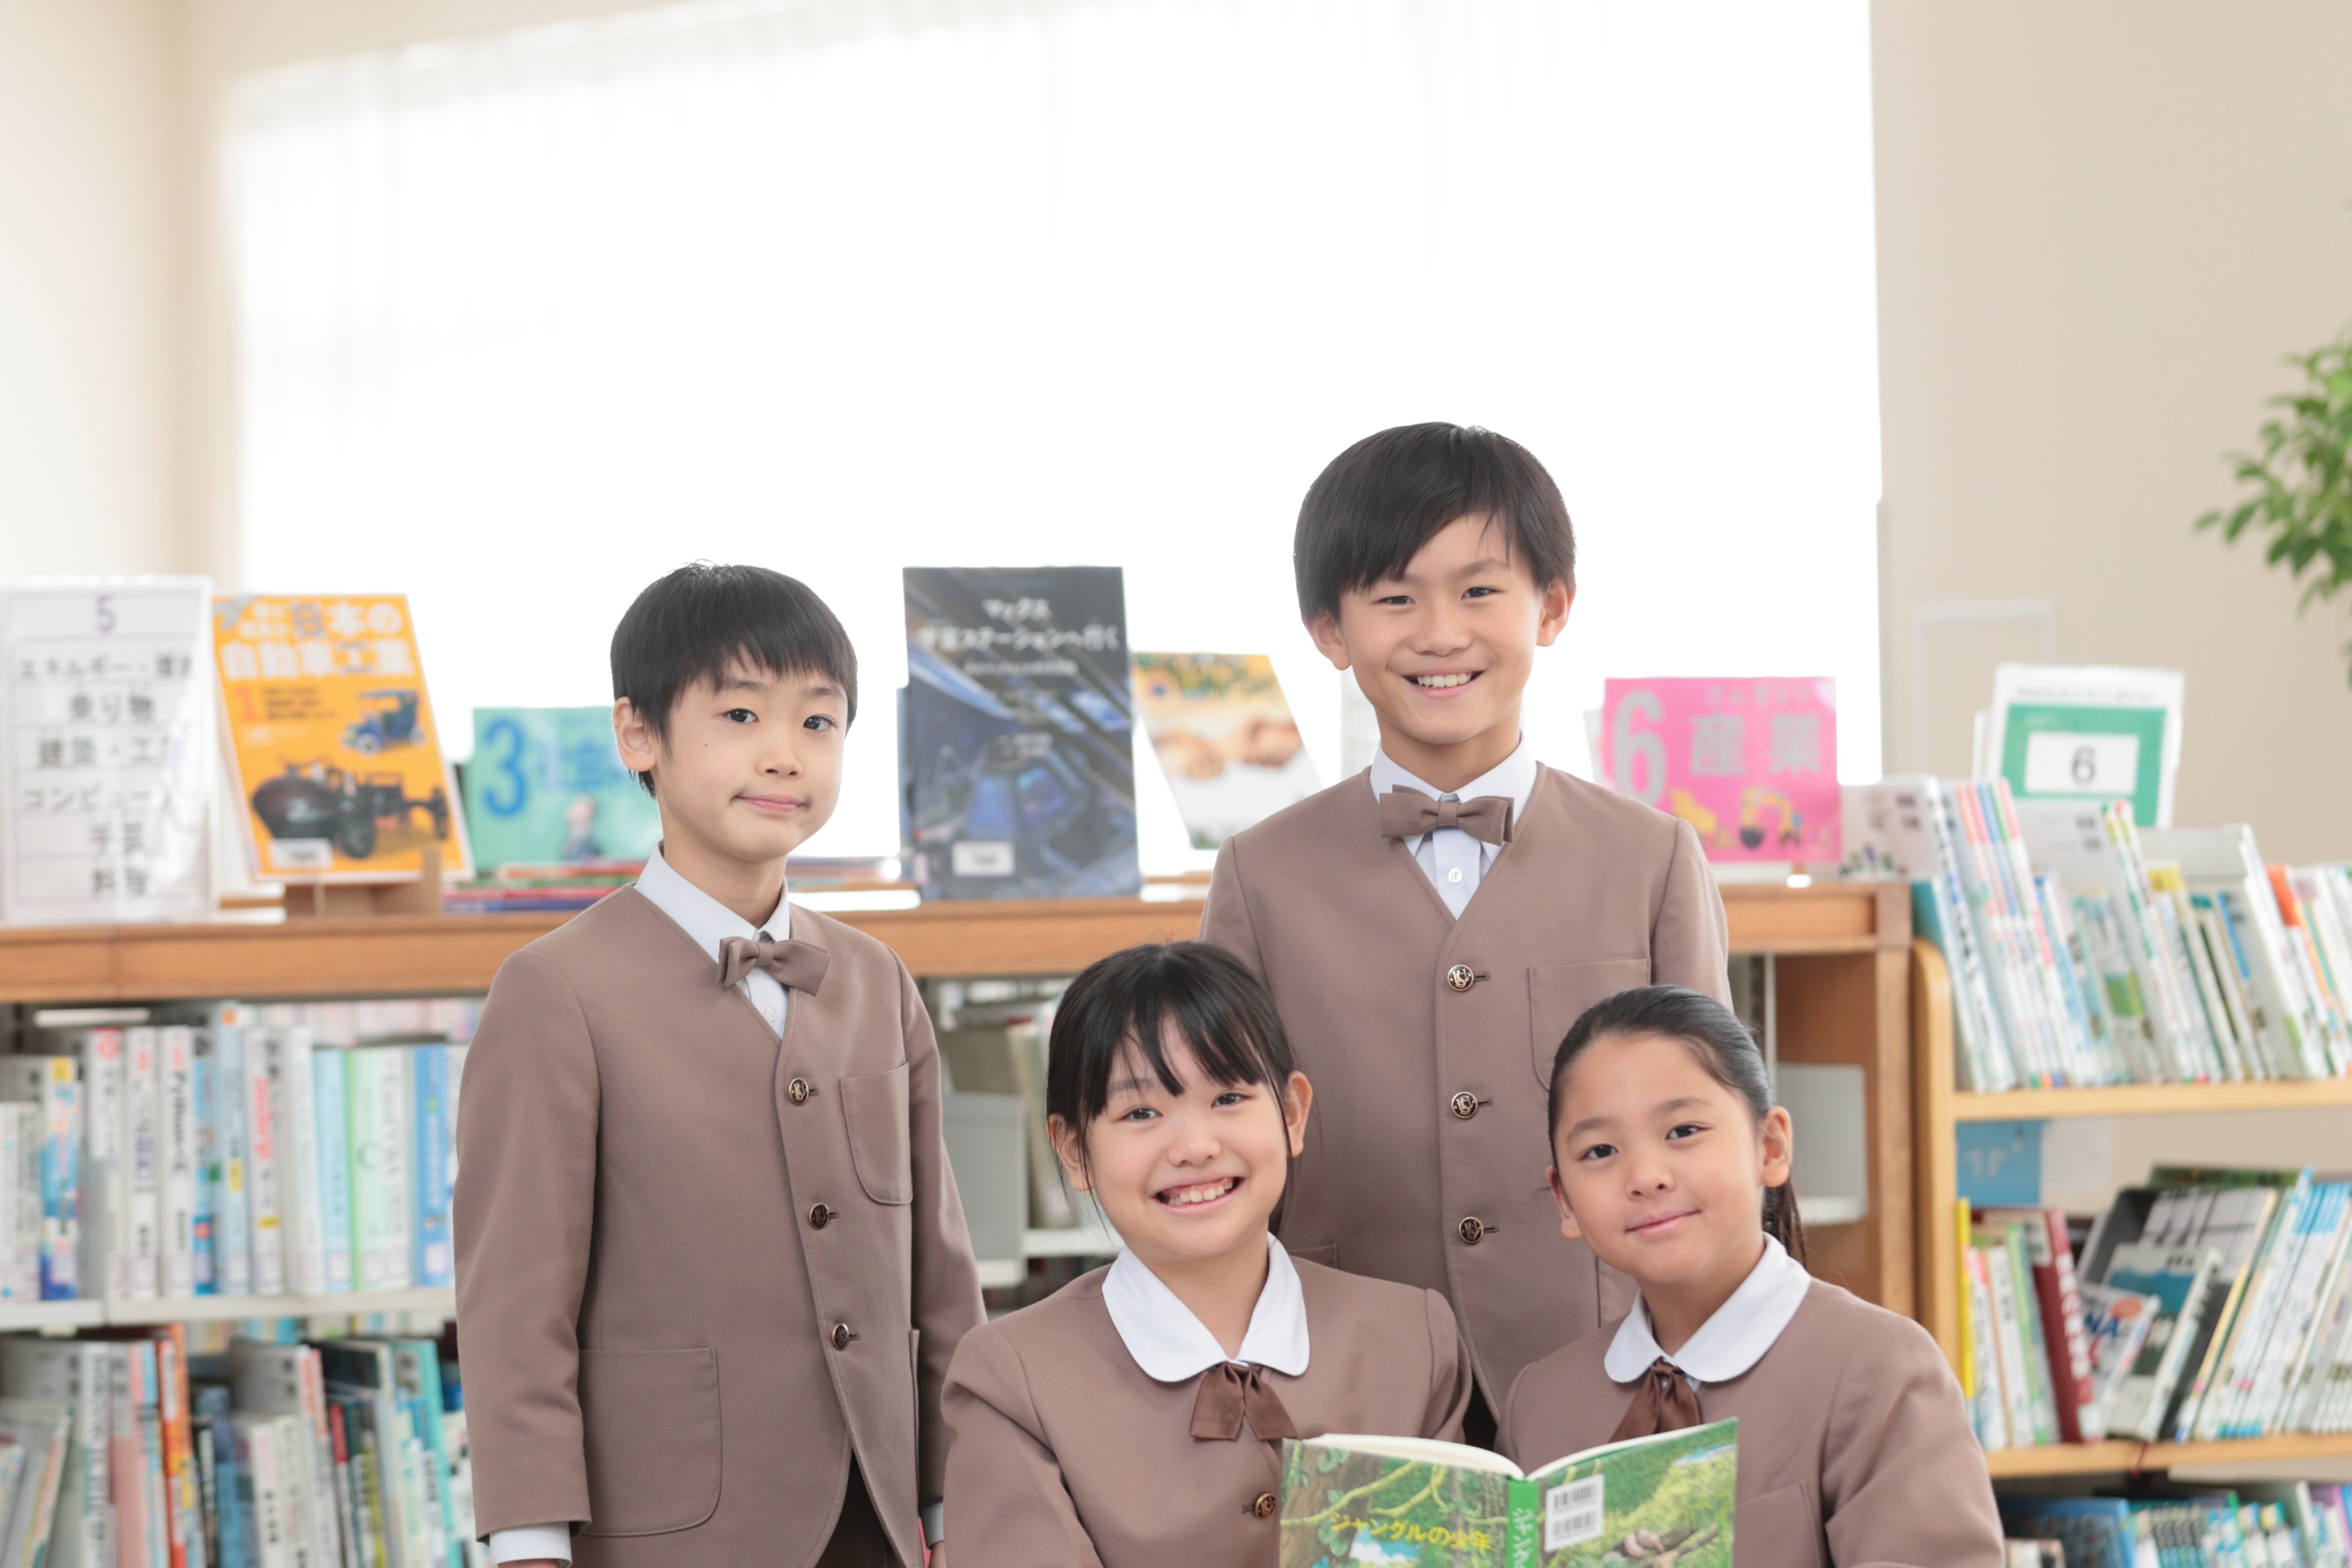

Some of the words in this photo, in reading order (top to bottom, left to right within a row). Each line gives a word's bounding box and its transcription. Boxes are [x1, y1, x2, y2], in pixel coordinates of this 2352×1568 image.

[96, 592, 117, 636] 5
[290, 599, 403, 638] 日本の
[483, 716, 526, 818] 3
[1612, 689, 1666, 809] 6
[1689, 713, 1822, 775] 産業
[2070, 743, 2098, 785] 6
[1330, 1511, 1493, 1556] ジャングルの少年
[1511, 1506, 1536, 1568] ジャング
